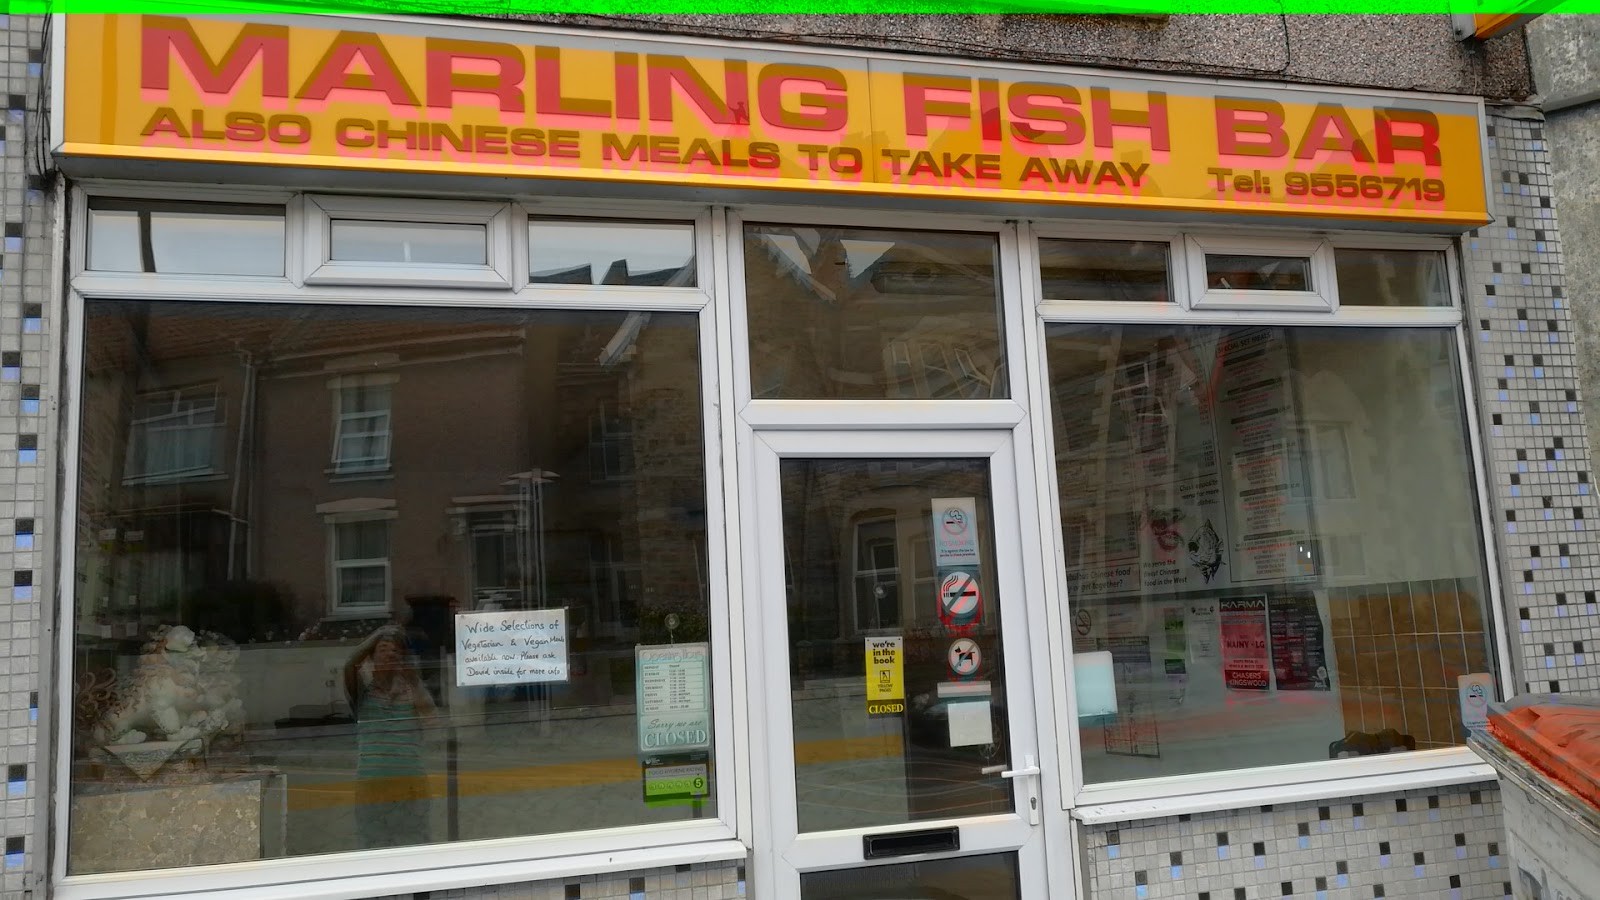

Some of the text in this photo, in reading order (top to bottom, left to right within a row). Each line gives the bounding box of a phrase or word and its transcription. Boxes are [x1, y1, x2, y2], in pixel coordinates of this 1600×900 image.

[140, 15, 1443, 166] MARLING FISH BAR
[140, 107, 1445, 203] ALSO CHINESE MEALS TO TAKE AWAY Tel: 9556719
[1115, 567, 1131, 576] food
[1220, 600, 1265, 609] KARMA
[465, 619, 560, 634] Wide Selections of
[461, 638, 504, 653] Vegetarian
[510, 638, 517, 647] &
[524, 635, 550, 649] Vegan
[872, 640, 896, 649] we're
[465, 652, 498, 664] available
[542, 652, 557, 660] ask
[873, 648, 896, 656] in the
[873, 656, 896, 665] book
[466, 666, 491, 677] David
[493, 667, 515, 676] inside
[516, 666, 526, 679] for
[529, 667, 545, 675] more
[1232, 671, 1262, 679] CHASERS
[868, 703, 904, 714] CLOSED
[648, 718, 674, 732] Sorry
[644, 729, 707, 748] CLOSED
